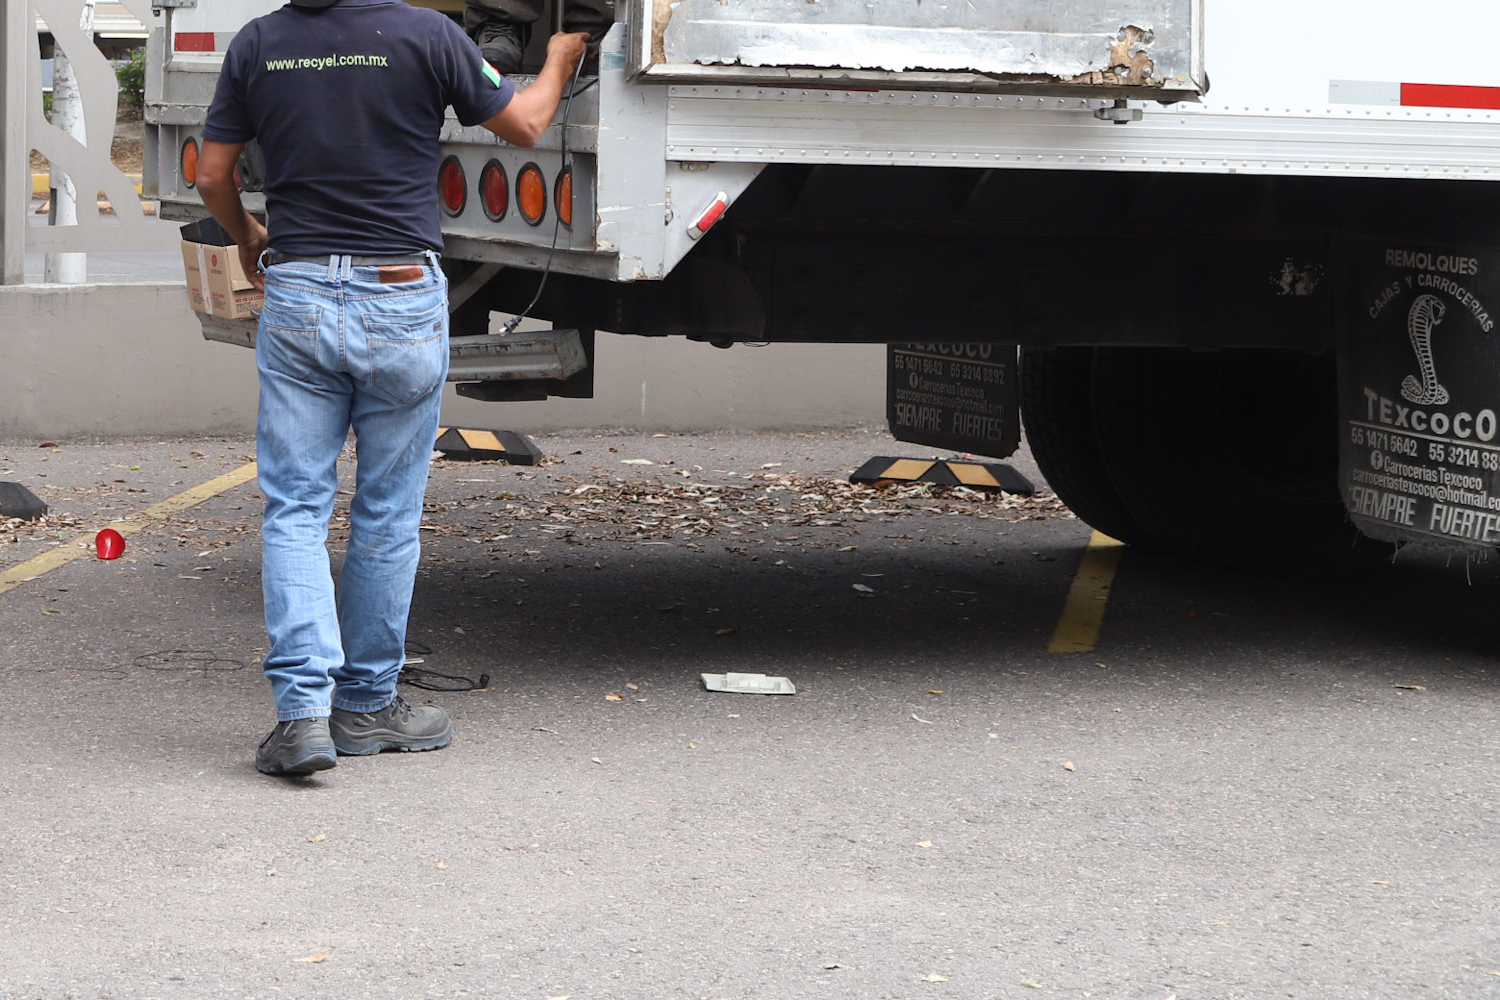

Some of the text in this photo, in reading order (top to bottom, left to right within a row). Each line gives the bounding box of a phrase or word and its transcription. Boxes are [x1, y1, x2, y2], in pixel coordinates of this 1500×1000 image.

[266, 53, 388, 71] www.recyel.com.mx
[1386, 249, 1478, 275] REMOLQUES
[1369, 274, 1494, 333] CAJAS Y CARROCERIAS
[894, 402, 1005, 441] SIEMPRE FUERTES
[1363, 386, 1497, 442] TEXCOCO
[1351, 427, 1500, 471] 55 1471 5642 55 3214 88
[1384, 455, 1483, 491] Carrocerias Texcoco
[1349, 485, 1417, 526] SIEMPRE
